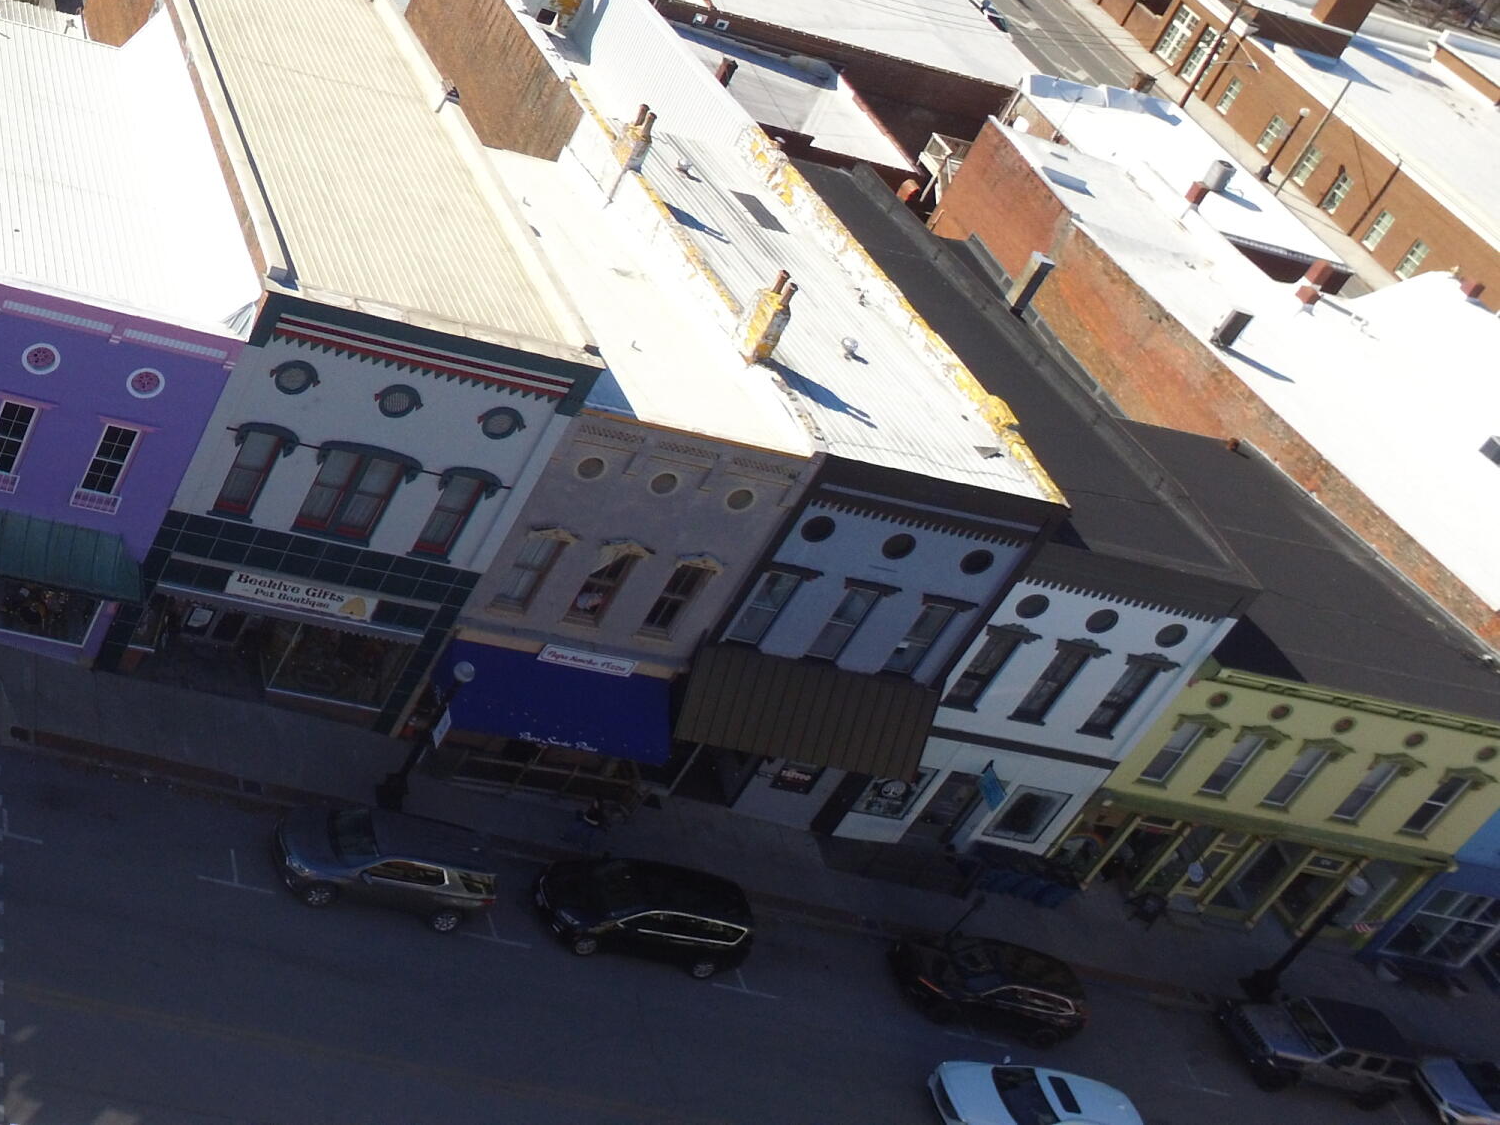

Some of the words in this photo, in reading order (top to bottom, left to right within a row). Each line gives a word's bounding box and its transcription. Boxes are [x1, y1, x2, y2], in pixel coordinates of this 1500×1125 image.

[236, 573, 301, 594] Beehive
[305, 586, 345, 603] Gifts
[253, 587, 276, 599] Pet
[277, 592, 331, 609] Boutique
